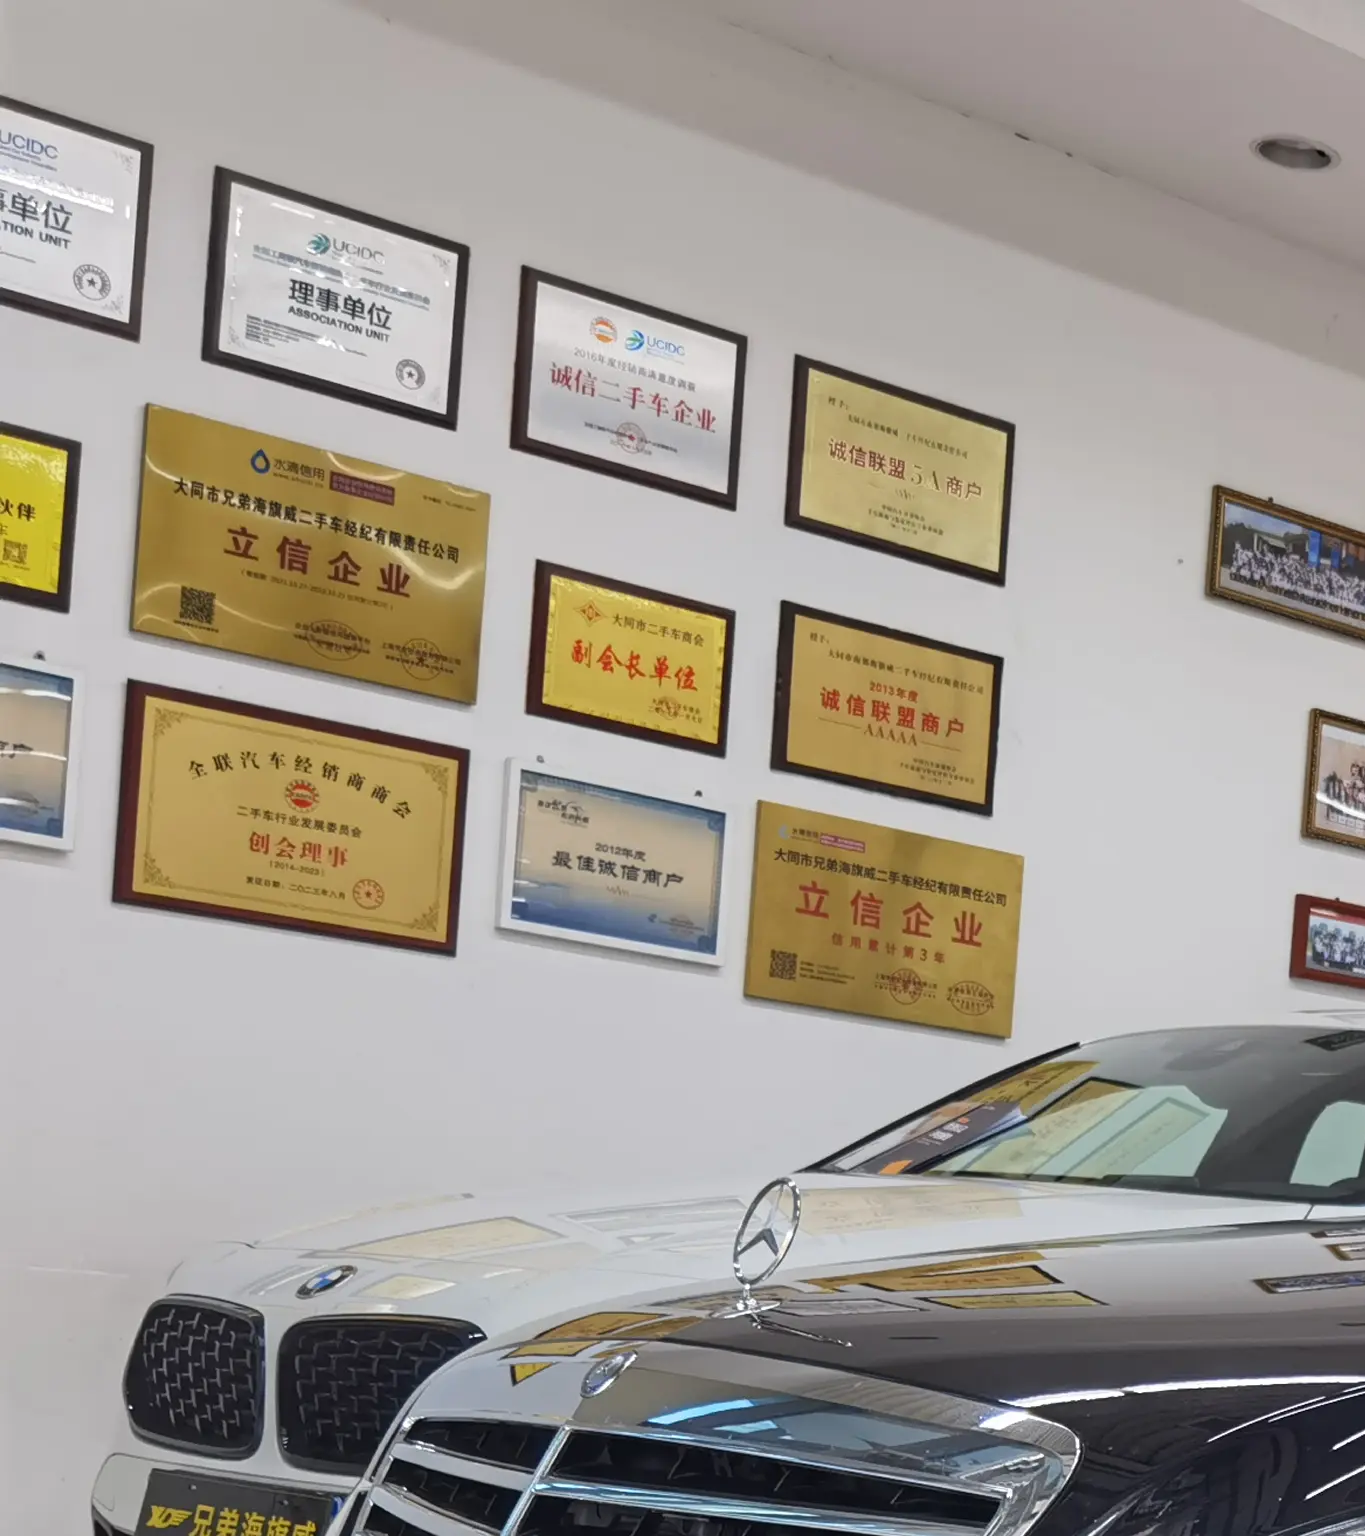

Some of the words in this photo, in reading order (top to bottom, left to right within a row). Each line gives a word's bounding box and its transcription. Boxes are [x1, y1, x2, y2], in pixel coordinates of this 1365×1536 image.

[0, 188, 73, 236] 单位
[39, 231, 72, 250] UNIT
[332, 238, 386, 264] UCIDC
[288, 278, 393, 331] 理事单位
[288, 305, 363, 336] ASSOCIATION
[365, 328, 391, 343] UNIT
[646, 335, 686, 357] UCIDC
[549, 362, 717, 433] 诚信二手车企业
[173, 477, 460, 564] 大同市兄弟海旗威二手车经纪有限责任公司
[223, 526, 411, 598] 立信企业
[612, 613, 705, 647] 大同市二手车商会
[571, 638, 698, 691] 副会长单位
[869, 680, 919, 703] 2013年度
[820, 686, 965, 738] 诚信联盟商户
[863, 723, 918, 746] AAAAA
[188, 751, 412, 819] 全联汽车经销商商会
[236, 805, 363, 838] 二手车行业发展委员会
[249, 831, 349, 868] 创会理事
[594, 842, 646, 862] 2012年度
[552, 850, 684, 888] 最佳诚信商户
[774, 847, 1007, 907] 大同市兄弟海旗威二手车经纪有限责任公司
[795, 880, 984, 948] 立信企业
[831, 932, 946, 964] 信用累计第3年
